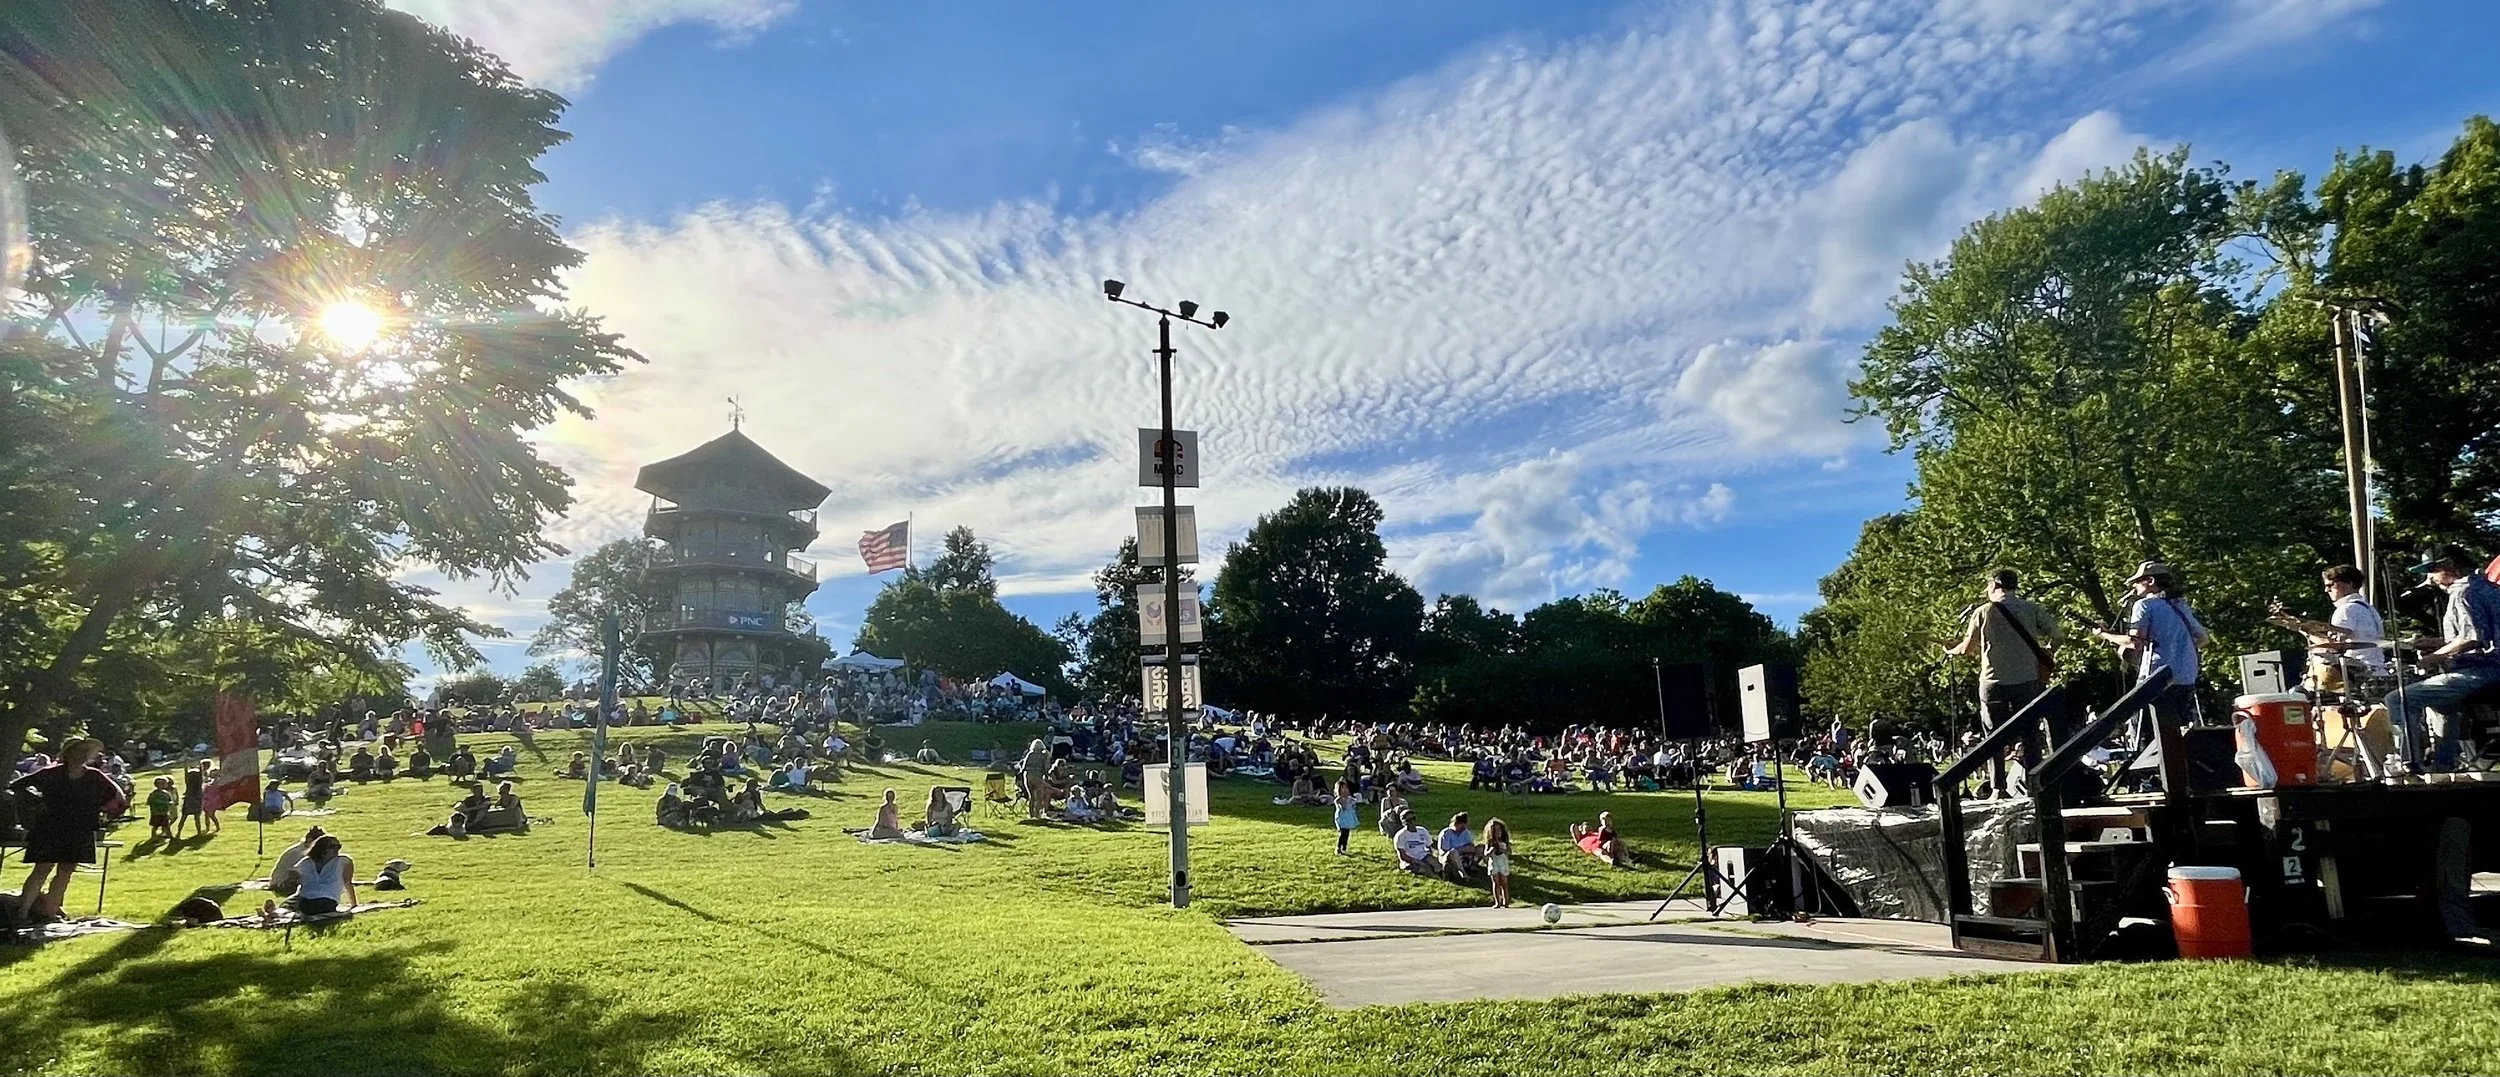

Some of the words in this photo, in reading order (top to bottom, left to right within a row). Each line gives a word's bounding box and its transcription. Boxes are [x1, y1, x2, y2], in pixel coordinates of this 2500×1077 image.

[740, 616, 763, 626] PNC
[2291, 827, 2306, 851] 2
[2288, 859, 2298, 873] 2
